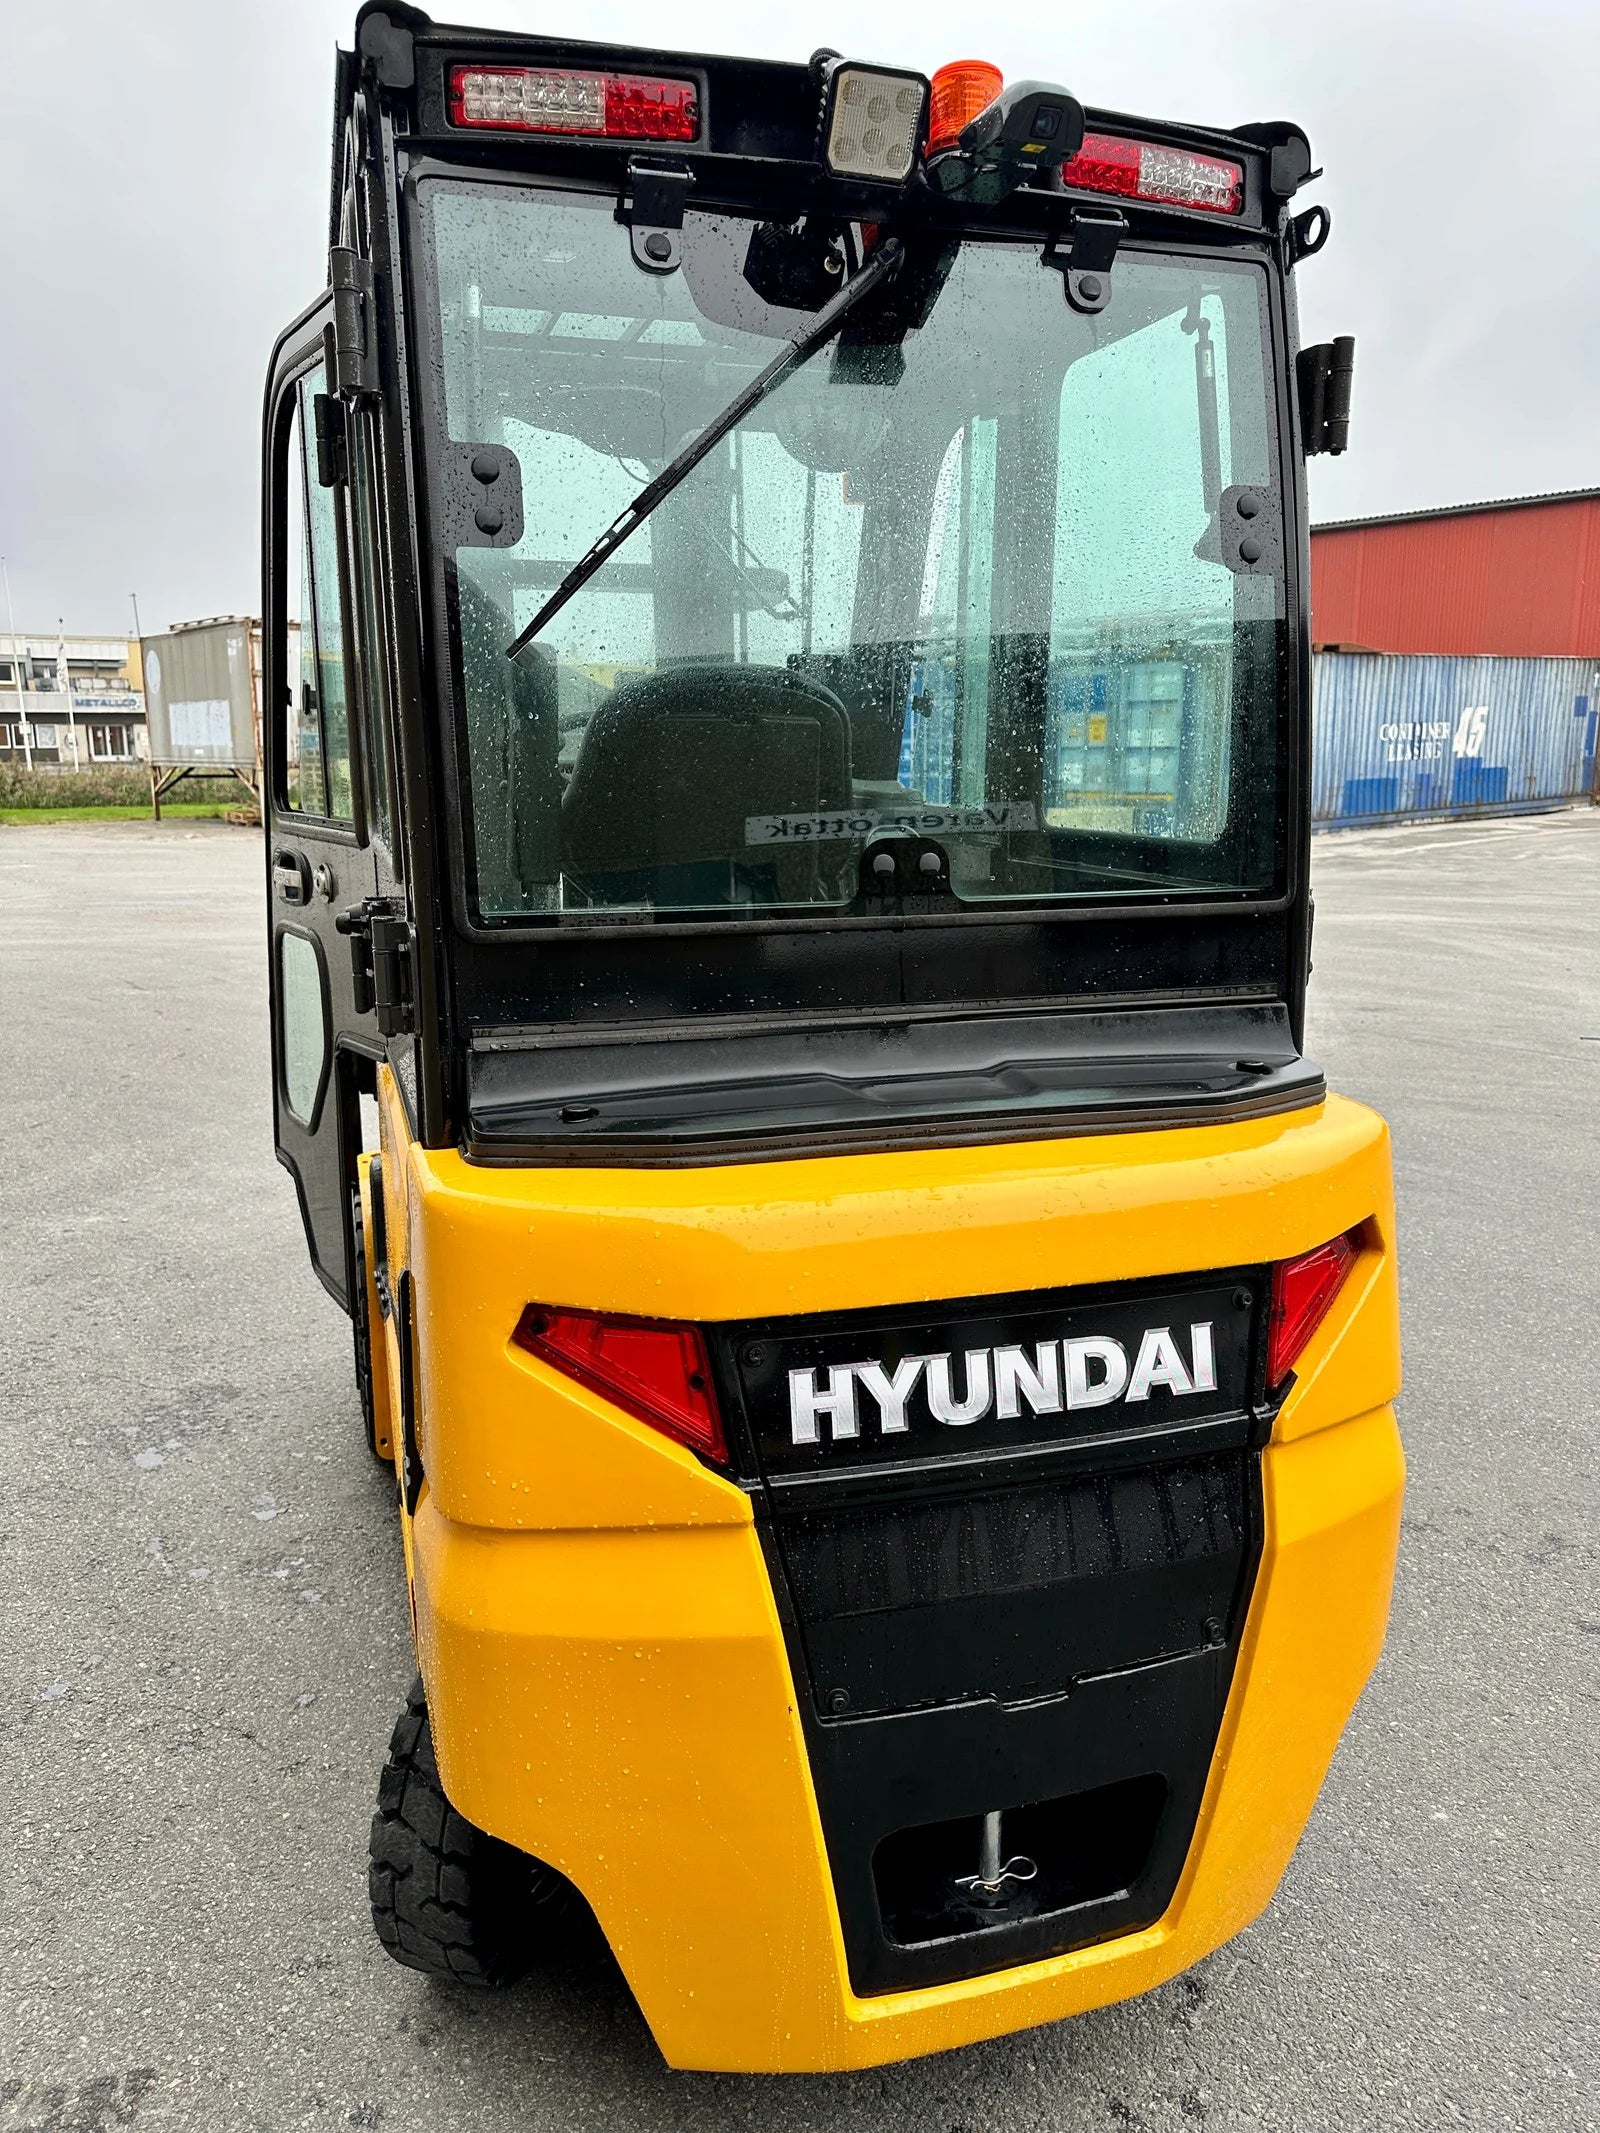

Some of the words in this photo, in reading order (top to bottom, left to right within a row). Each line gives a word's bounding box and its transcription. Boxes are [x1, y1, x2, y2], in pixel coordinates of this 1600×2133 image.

[1379, 721, 1451, 742] CONTAINER
[1388, 742, 1443, 761] LEASING
[789, 1321, 1218, 1445] HYUNDAI
